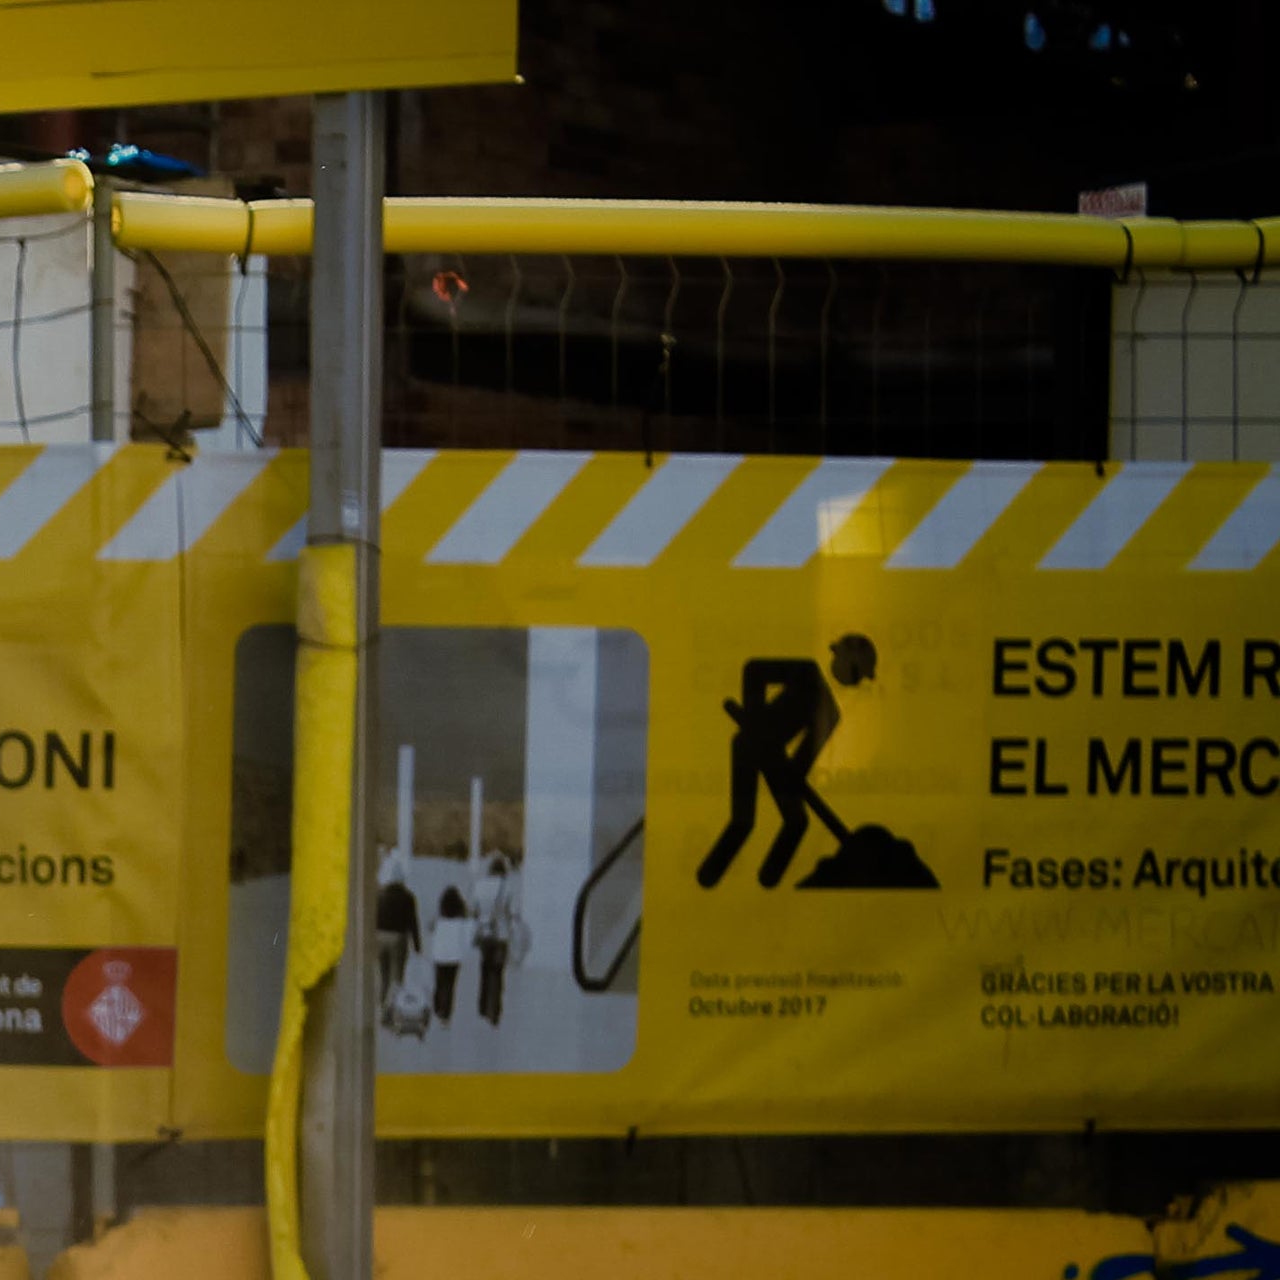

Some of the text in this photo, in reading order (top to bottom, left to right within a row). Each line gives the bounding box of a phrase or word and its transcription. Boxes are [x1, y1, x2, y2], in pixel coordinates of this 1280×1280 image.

[992, 637, 1221, 697] ESTEM
[989, 737, 1069, 795] EL
[1087, 737, 1280, 796] MERC
[983, 848, 1124, 887] Fases:
[1094, 973, 1141, 994] PER
[1146, 972, 1175, 993] LA
[1181, 971, 1274, 994] VOSTRA
